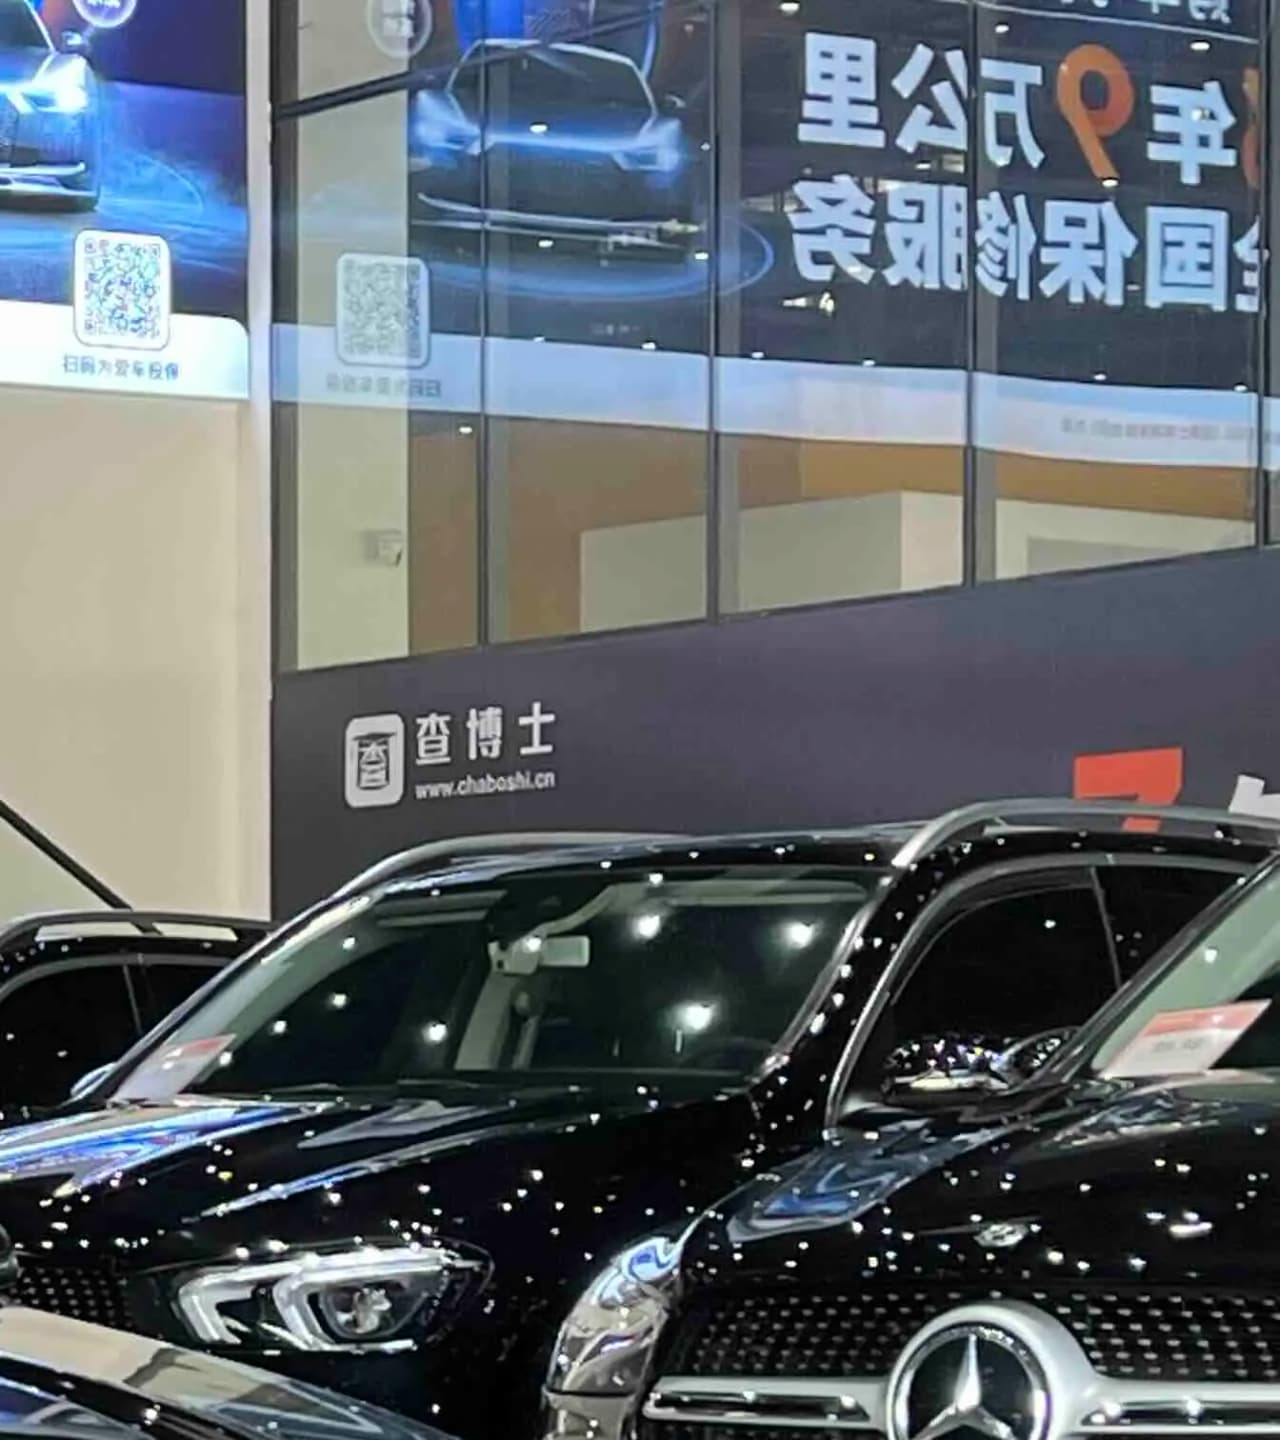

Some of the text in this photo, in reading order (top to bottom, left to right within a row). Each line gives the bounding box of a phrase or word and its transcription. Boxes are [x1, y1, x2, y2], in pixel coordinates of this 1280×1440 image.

[415, 702, 556, 765] 查博士
[415, 771, 556, 800] www.chaboshi.cn
